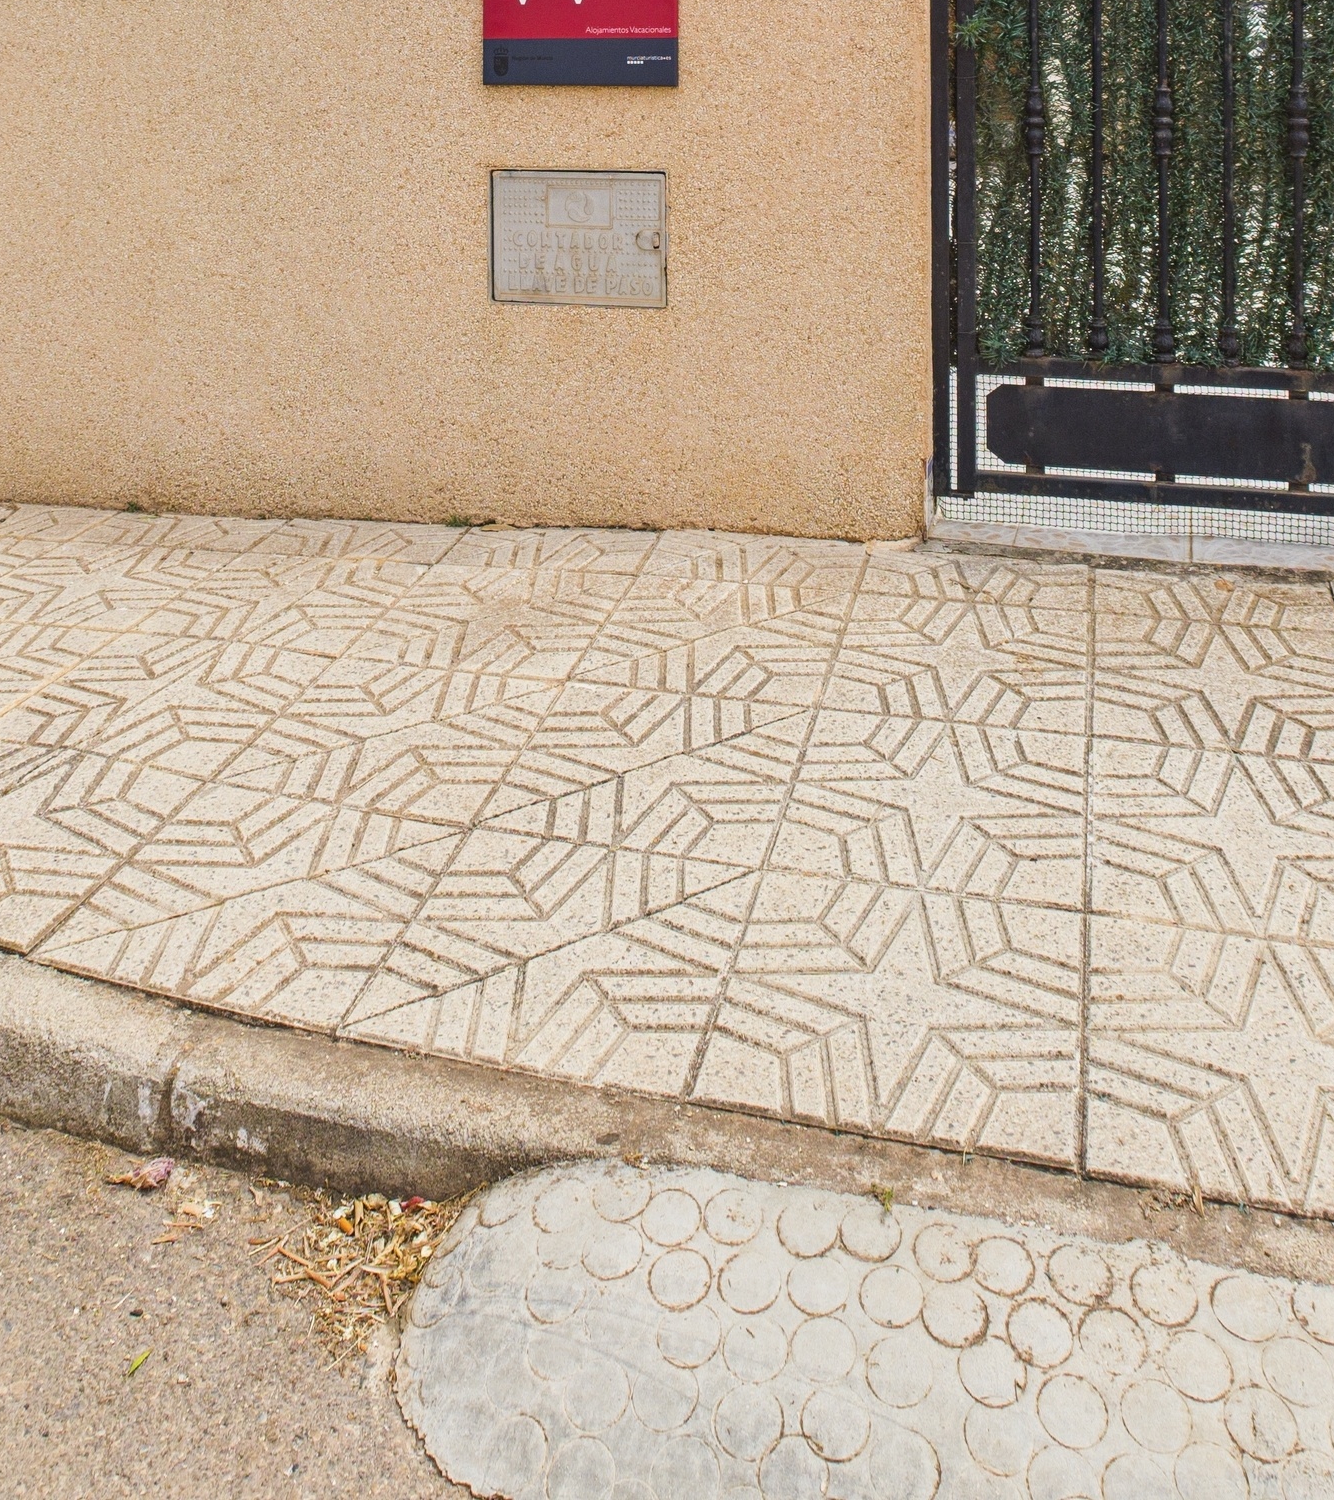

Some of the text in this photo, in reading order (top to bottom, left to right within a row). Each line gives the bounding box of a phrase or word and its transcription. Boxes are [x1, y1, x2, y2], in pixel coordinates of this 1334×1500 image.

[585, 26, 672, 36] Alojamientos Vacacionales
[513, 230, 623, 250] CONTADOR
[518, 252, 617, 273] DE AGUA
[508, 273, 654, 296] LLAVE DE PASO
